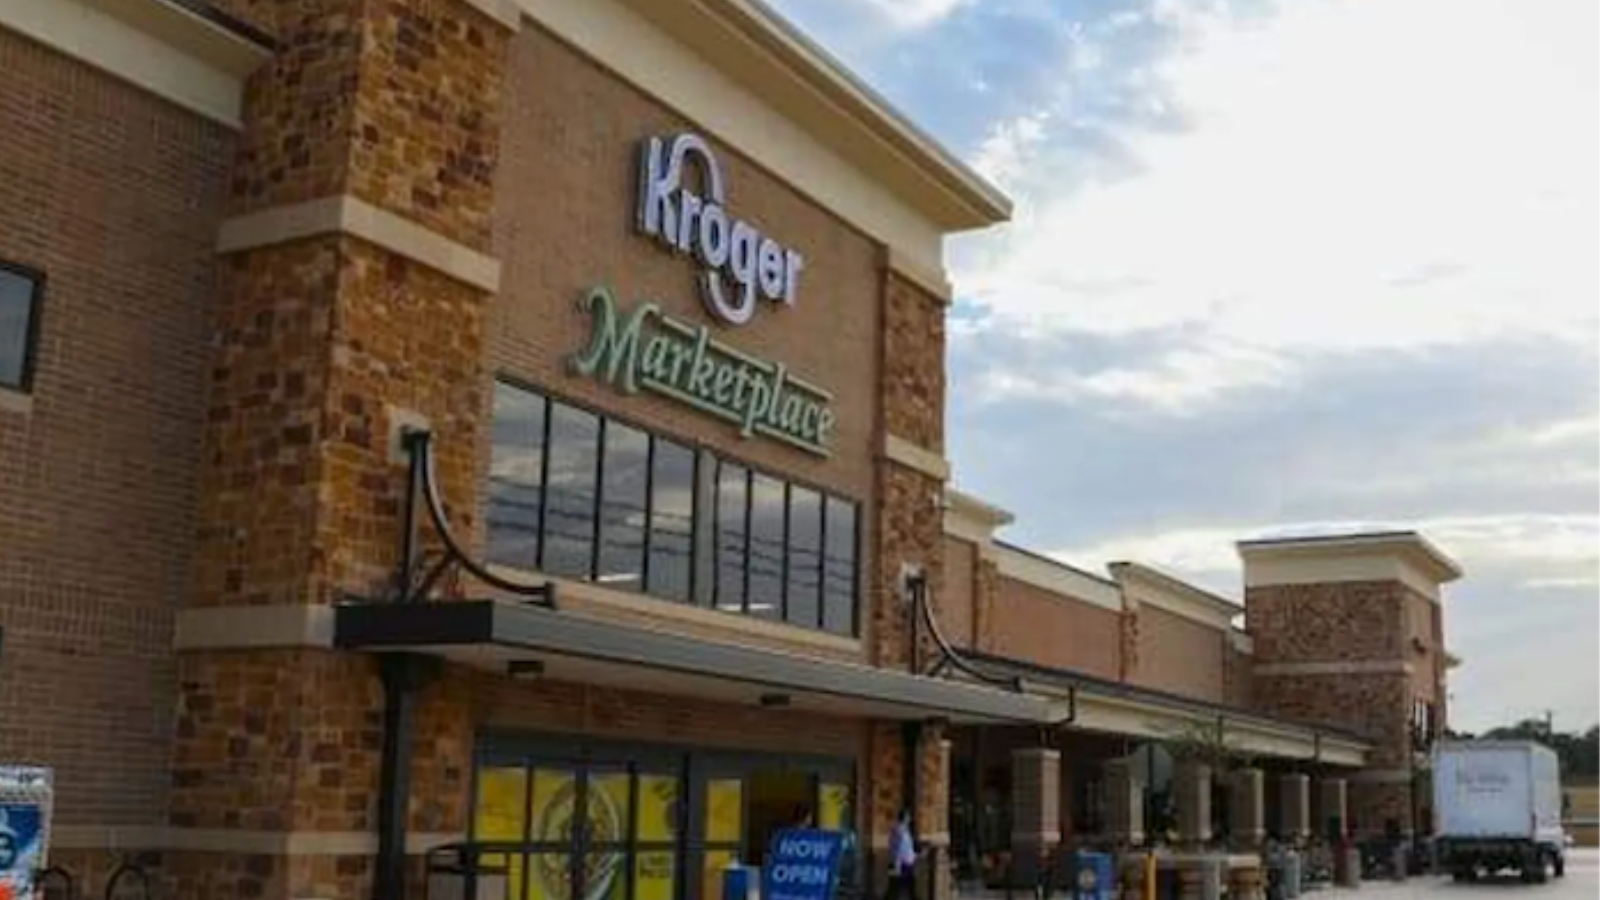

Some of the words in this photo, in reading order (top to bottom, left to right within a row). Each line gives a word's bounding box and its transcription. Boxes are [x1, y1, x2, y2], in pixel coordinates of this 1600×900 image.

[640, 132, 804, 325] Kroger
[576, 286, 836, 446] Marketplace
[772, 865, 829, 883] OPEN
[780, 839, 833, 858] NOW
